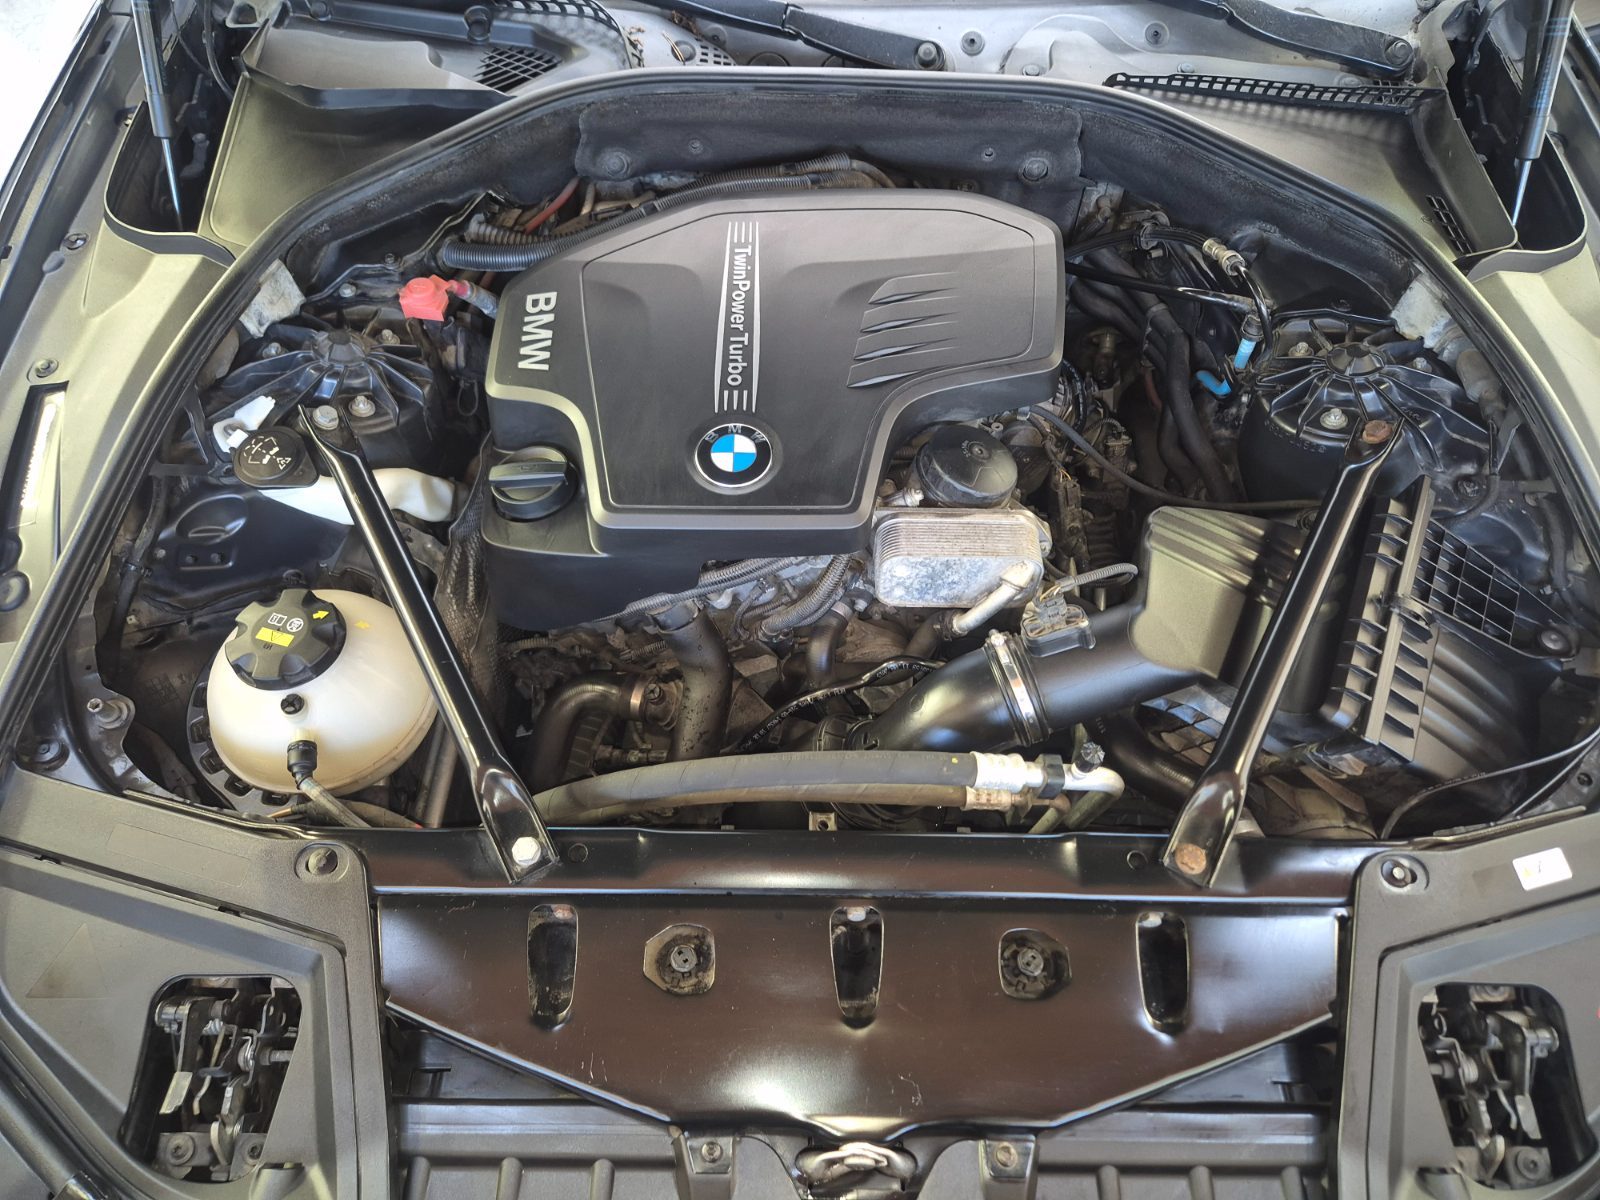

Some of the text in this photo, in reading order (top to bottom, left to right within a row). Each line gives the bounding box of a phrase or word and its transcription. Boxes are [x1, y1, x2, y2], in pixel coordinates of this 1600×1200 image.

[517, 291, 558, 371] BMW
[727, 244, 752, 387] TwinPower Turbo
[704, 424, 767, 444] BMW
